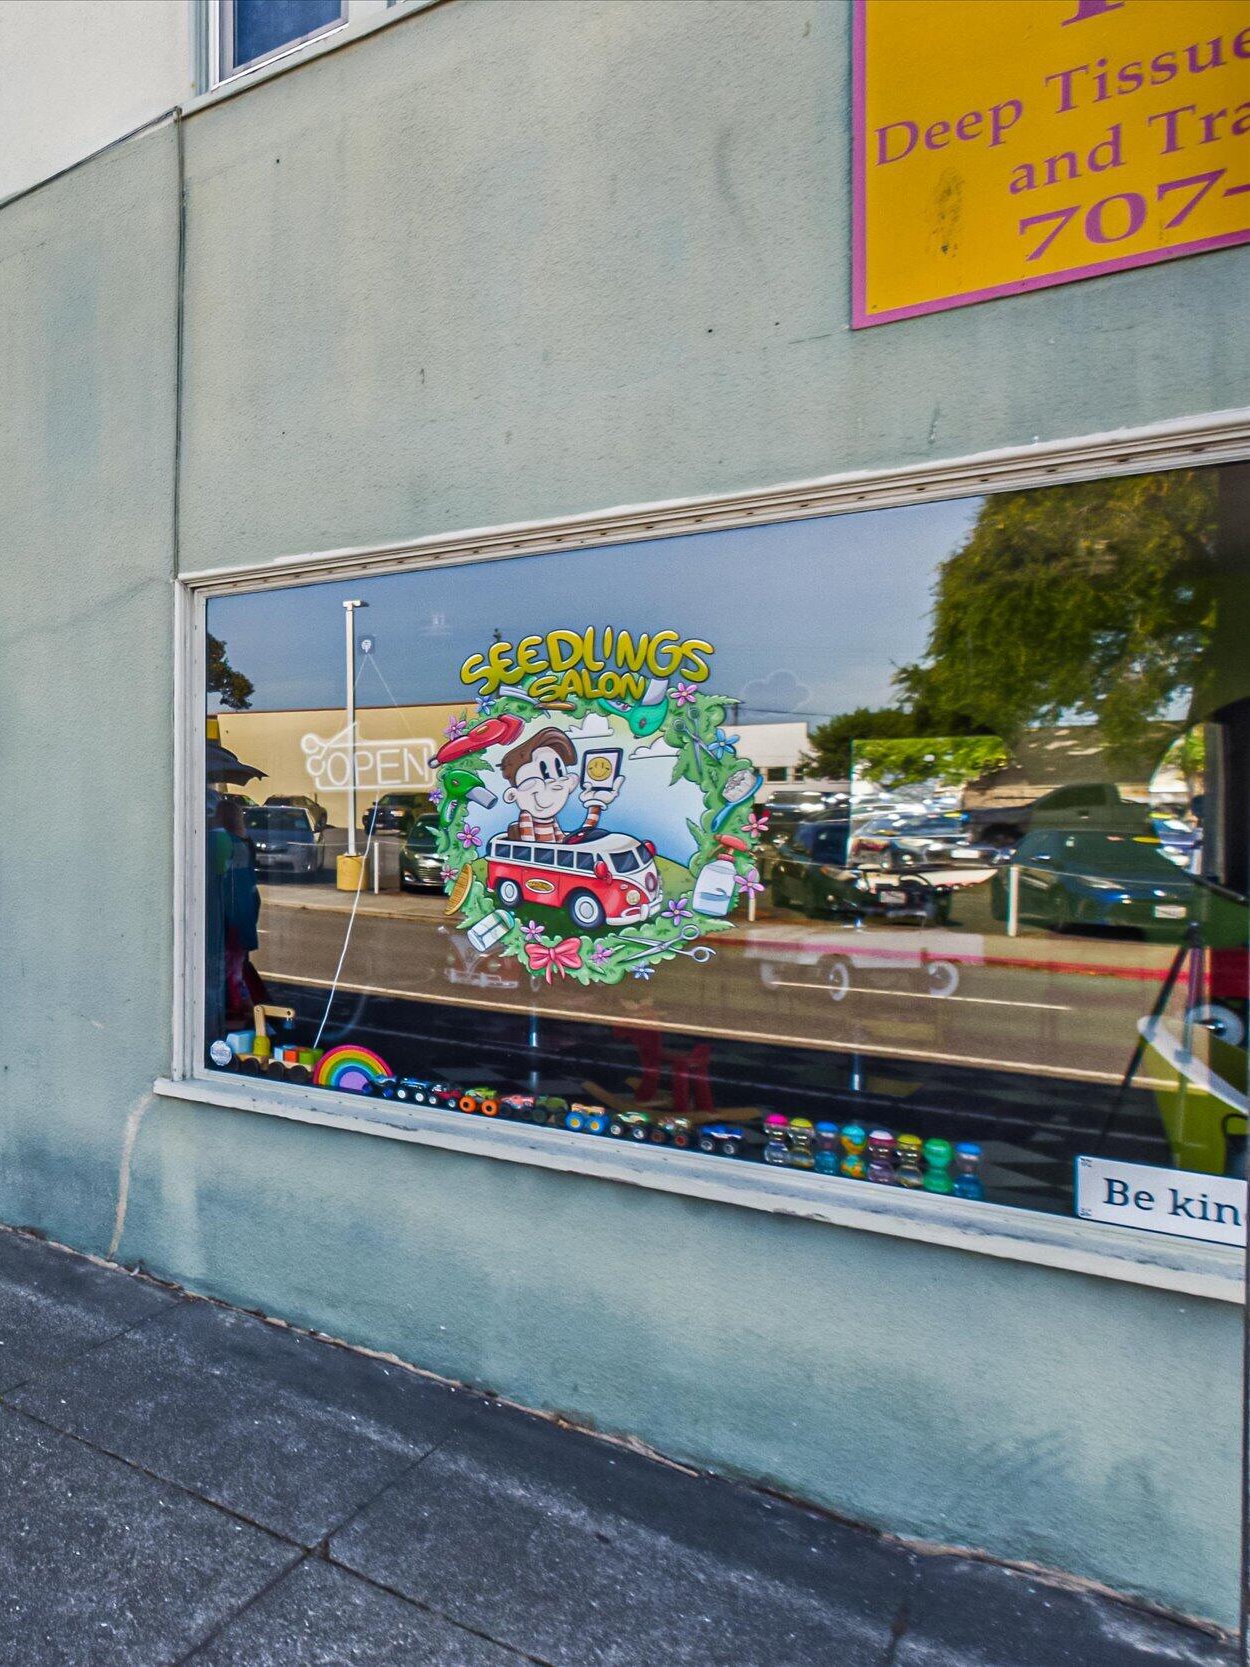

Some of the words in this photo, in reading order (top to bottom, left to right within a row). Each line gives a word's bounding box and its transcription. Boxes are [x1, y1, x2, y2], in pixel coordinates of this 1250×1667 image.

[874, 99, 1024, 166] Deep
[1044, 26, 1250, 114] Tissue
[1008, 123, 1128, 195] and
[460, 626, 715, 696] SEEDLINGS
[529, 669, 646, 702] SALON
[327, 748, 430, 786] OPEN
[1103, 1177, 1155, 1211] Be
[1168, 1188, 1242, 1227] kin
